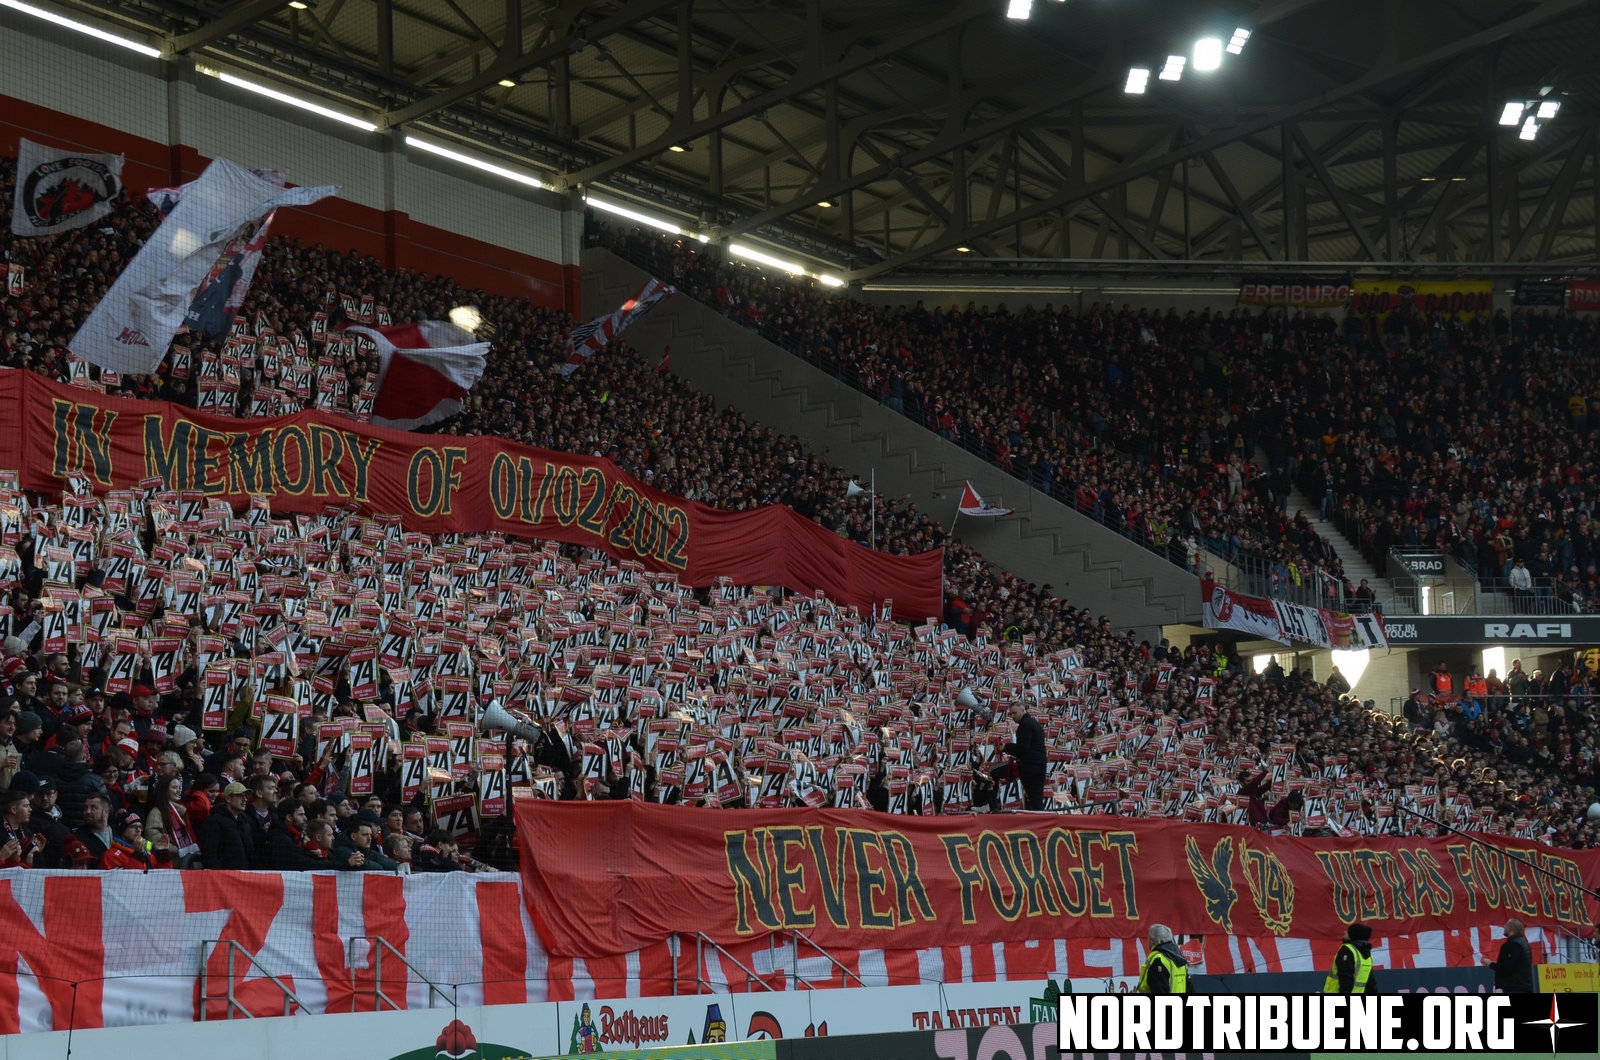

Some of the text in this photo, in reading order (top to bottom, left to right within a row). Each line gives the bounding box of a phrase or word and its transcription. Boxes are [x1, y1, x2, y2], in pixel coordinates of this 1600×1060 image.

[35, 162, 64, 177] LOVE
[10, 270, 24, 288] 74
[1241, 284, 1349, 304] FREIBURG
[202, 388, 217, 406] 74
[220, 390, 236, 408] 74
[254, 400, 269, 416] 74
[52, 398, 690, 570] IN MEMORY OF 01/02/2012
[66, 504, 82, 526] 74
[182, 500, 204, 520] 74
[142, 578, 162, 600] 74
[482, 568, 500, 588] 74
[224, 602, 246, 624] 74
[386, 592, 400, 612] 74
[418, 602, 433, 618] 74
[47, 610, 65, 638] 74
[332, 604, 352, 626] 74
[526, 610, 538, 628] 74
[1384, 624, 1415, 632] GET IN
[1386, 630, 1418, 639] TOUCH
[1484, 624, 1572, 638] RAFI
[382, 630, 407, 658] 74
[549, 638, 568, 658] 74
[613, 632, 628, 650] 74
[112, 650, 135, 680] 74
[154, 650, 175, 678] 74
[316, 654, 346, 675] 74
[352, 658, 374, 687] 74
[438, 650, 459, 674] 74
[414, 664, 434, 684] 74
[634, 668, 644, 686] 74
[206, 682, 225, 712] 74
[298, 682, 310, 706] 74
[398, 682, 413, 704] 74
[510, 678, 534, 700] 74
[442, 690, 468, 716] 74
[264, 708, 294, 742] 74
[954, 710, 968, 728] 74
[452, 736, 470, 764] 74
[812, 735, 822, 756] 74
[354, 747, 371, 776] 74
[584, 751, 604, 778] 74
[903, 748, 914, 766] 74
[952, 750, 969, 768] 74
[404, 756, 424, 786] 74
[634, 768, 644, 790] 74
[1274, 762, 1286, 782] 74
[484, 769, 504, 800] 74
[762, 772, 784, 796] 74
[948, 782, 960, 802] 74
[1002, 780, 1020, 803] 74
[838, 786, 852, 808] 74
[892, 790, 907, 814] 74
[1308, 798, 1322, 814] 74
[440, 806, 476, 834] 74
[1237, 806, 1249, 824] 74
[1422, 804, 1434, 820] 74
[724, 826, 1140, 934] NEVER FORGET
[1314, 840, 1595, 927] ULTRAS FOREVER
[1551, 968, 1566, 980] LOTTO
[598, 1005, 669, 1048] Rothaus
